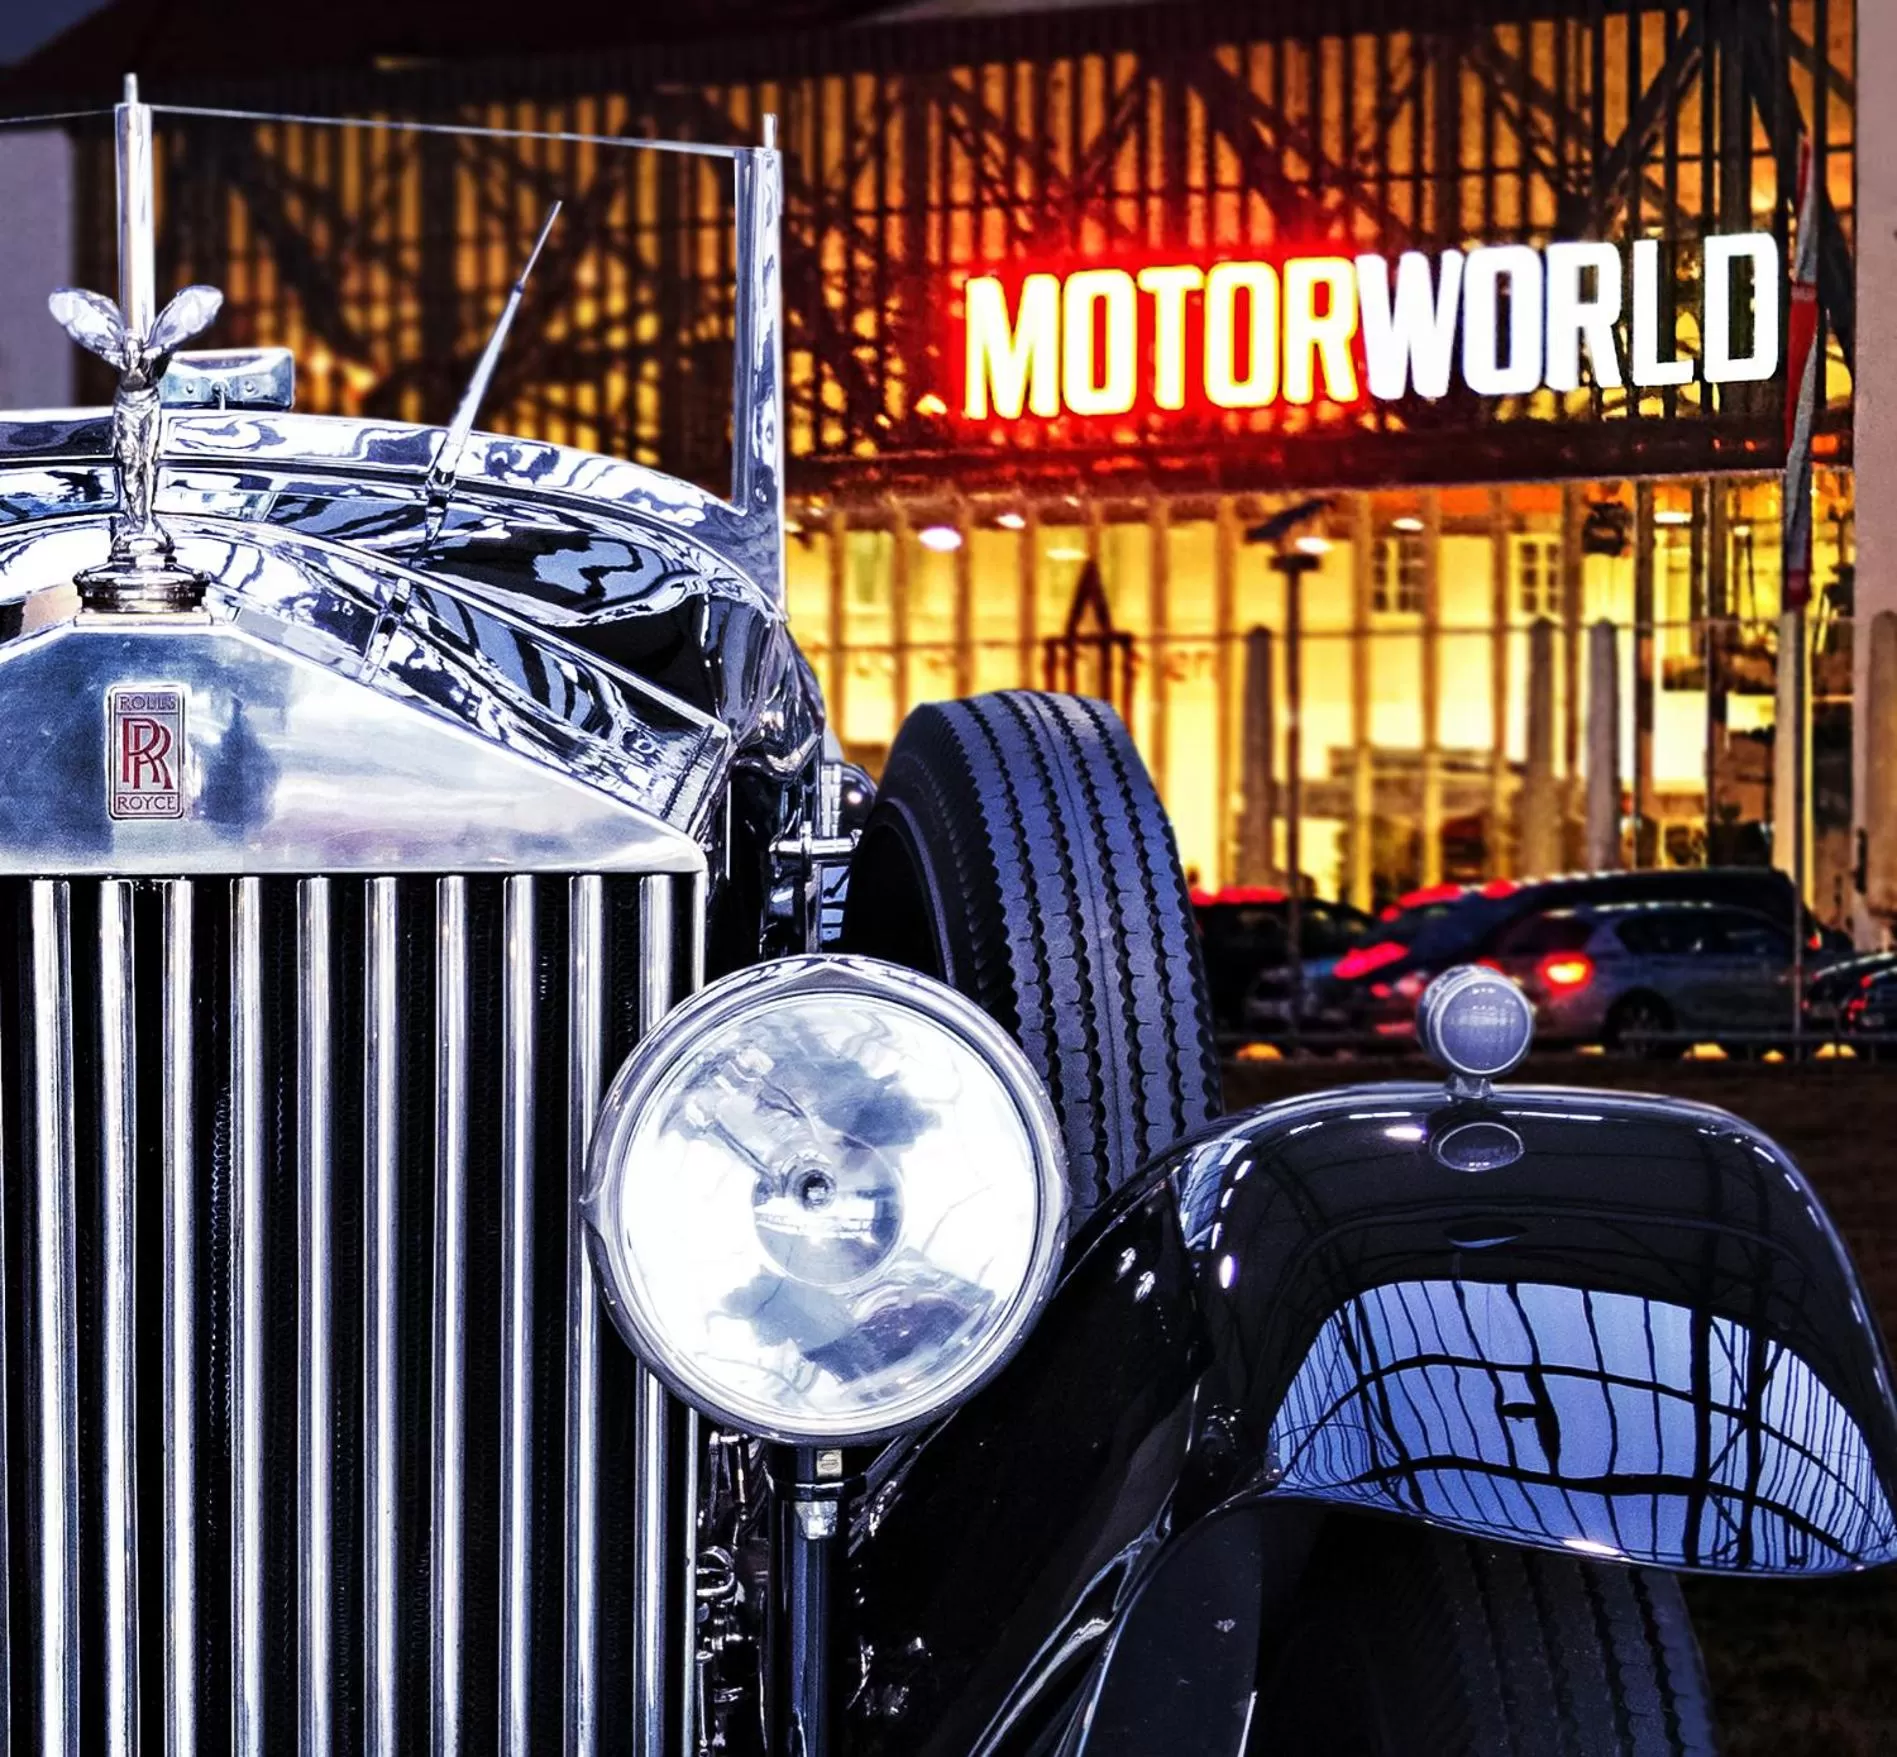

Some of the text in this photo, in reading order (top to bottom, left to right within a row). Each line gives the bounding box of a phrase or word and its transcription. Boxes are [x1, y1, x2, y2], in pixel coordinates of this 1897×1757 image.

[965, 232, 1779, 420] MOTORWORLD
[119, 696, 176, 711] ROLLS
[117, 796, 176, 810] ROYCE
